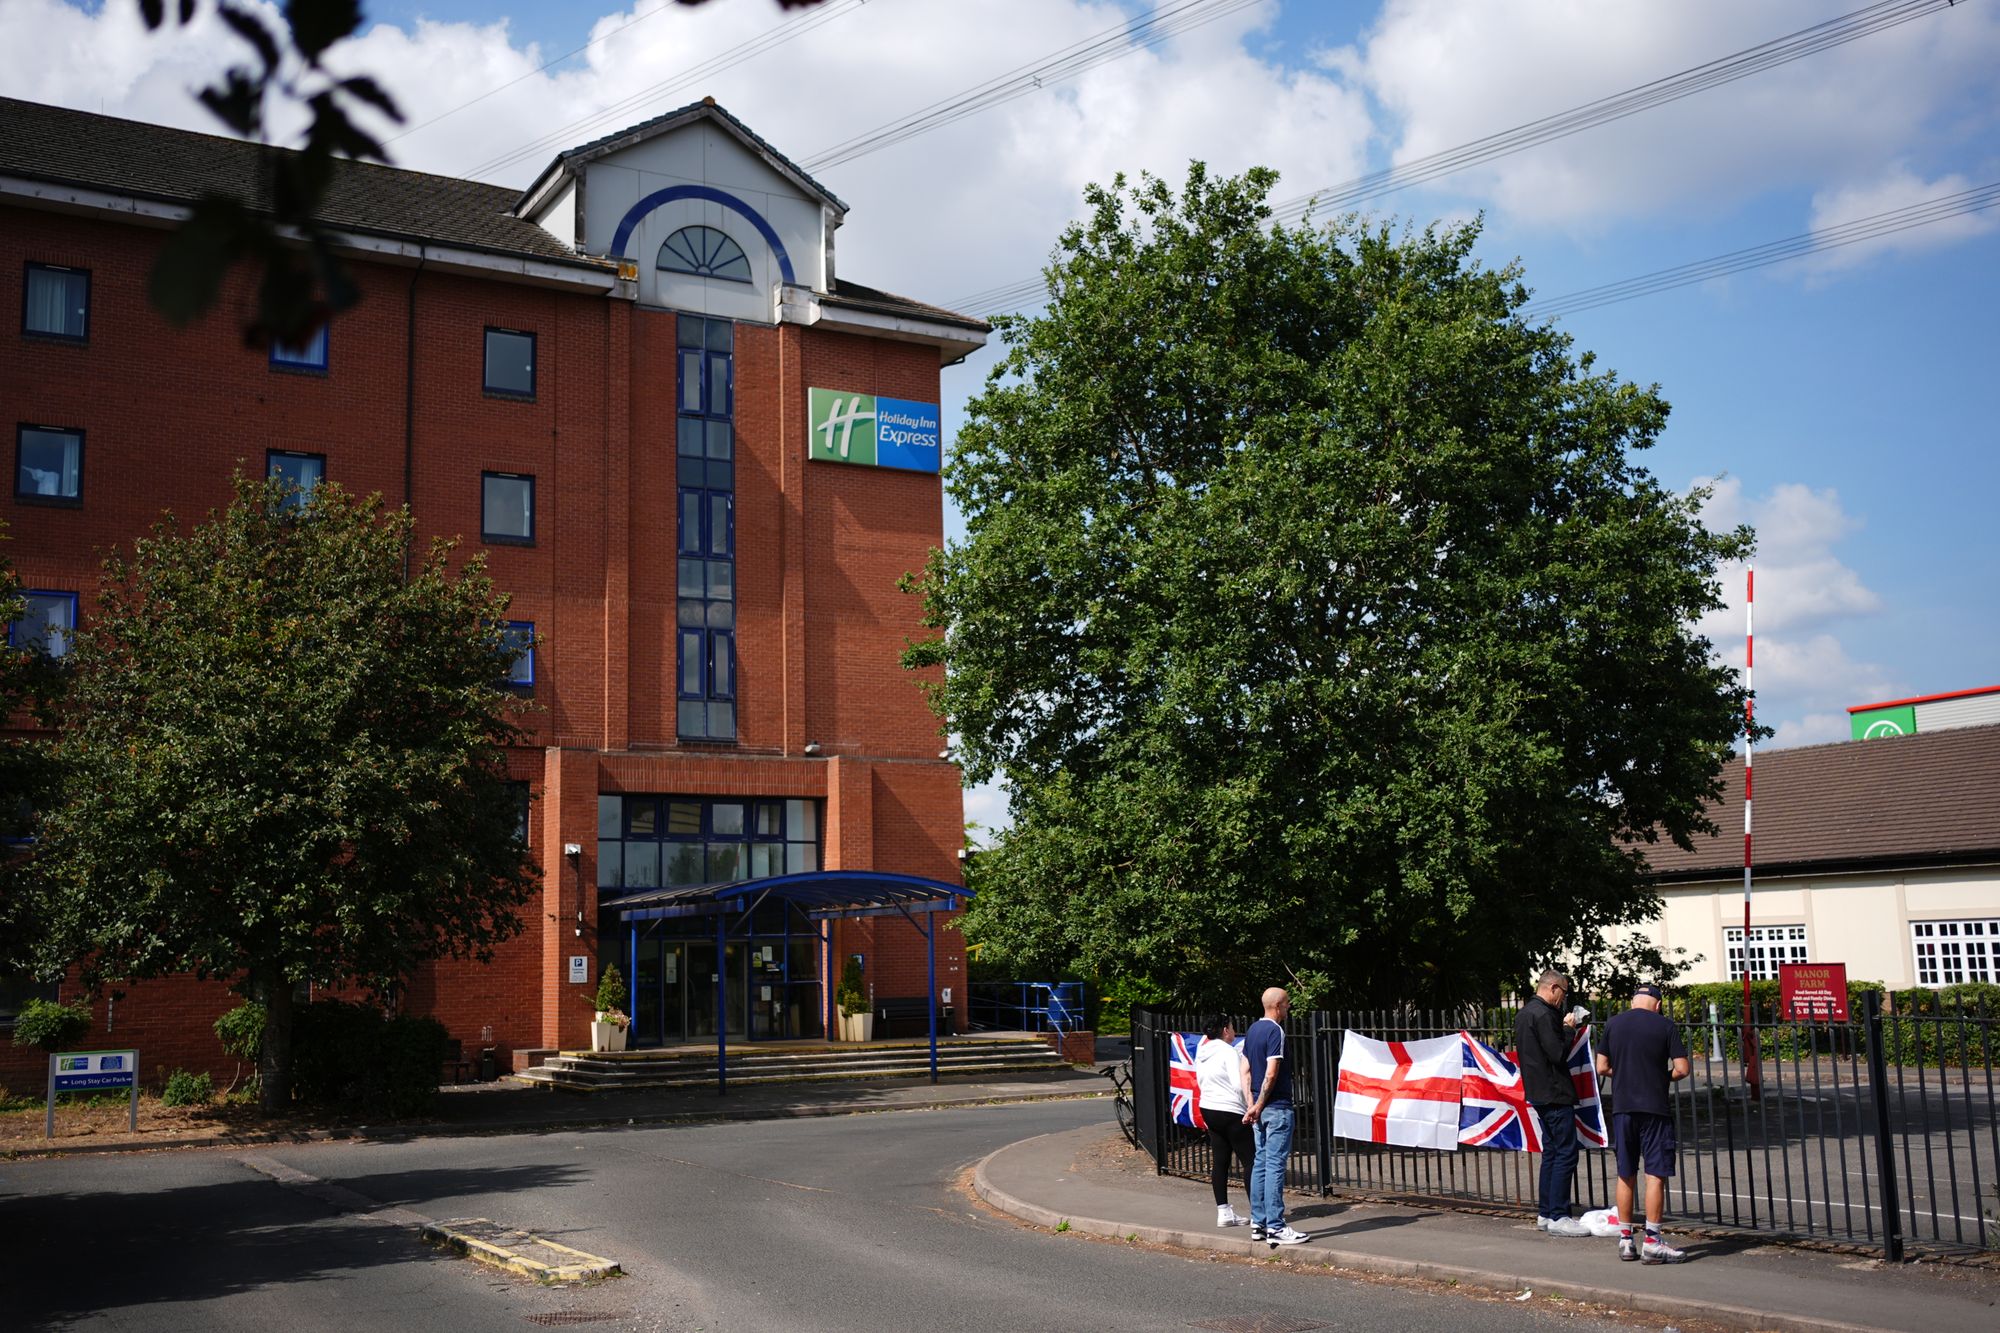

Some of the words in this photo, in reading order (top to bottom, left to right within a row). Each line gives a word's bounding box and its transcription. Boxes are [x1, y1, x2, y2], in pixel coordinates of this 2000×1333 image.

[879, 410, 920, 430] Holiday
[920, 416, 936, 429] Inn
[880, 425, 936, 447] Express
[1794, 970, 1830, 978] MANOR
[1800, 980, 1825, 988] FARM
